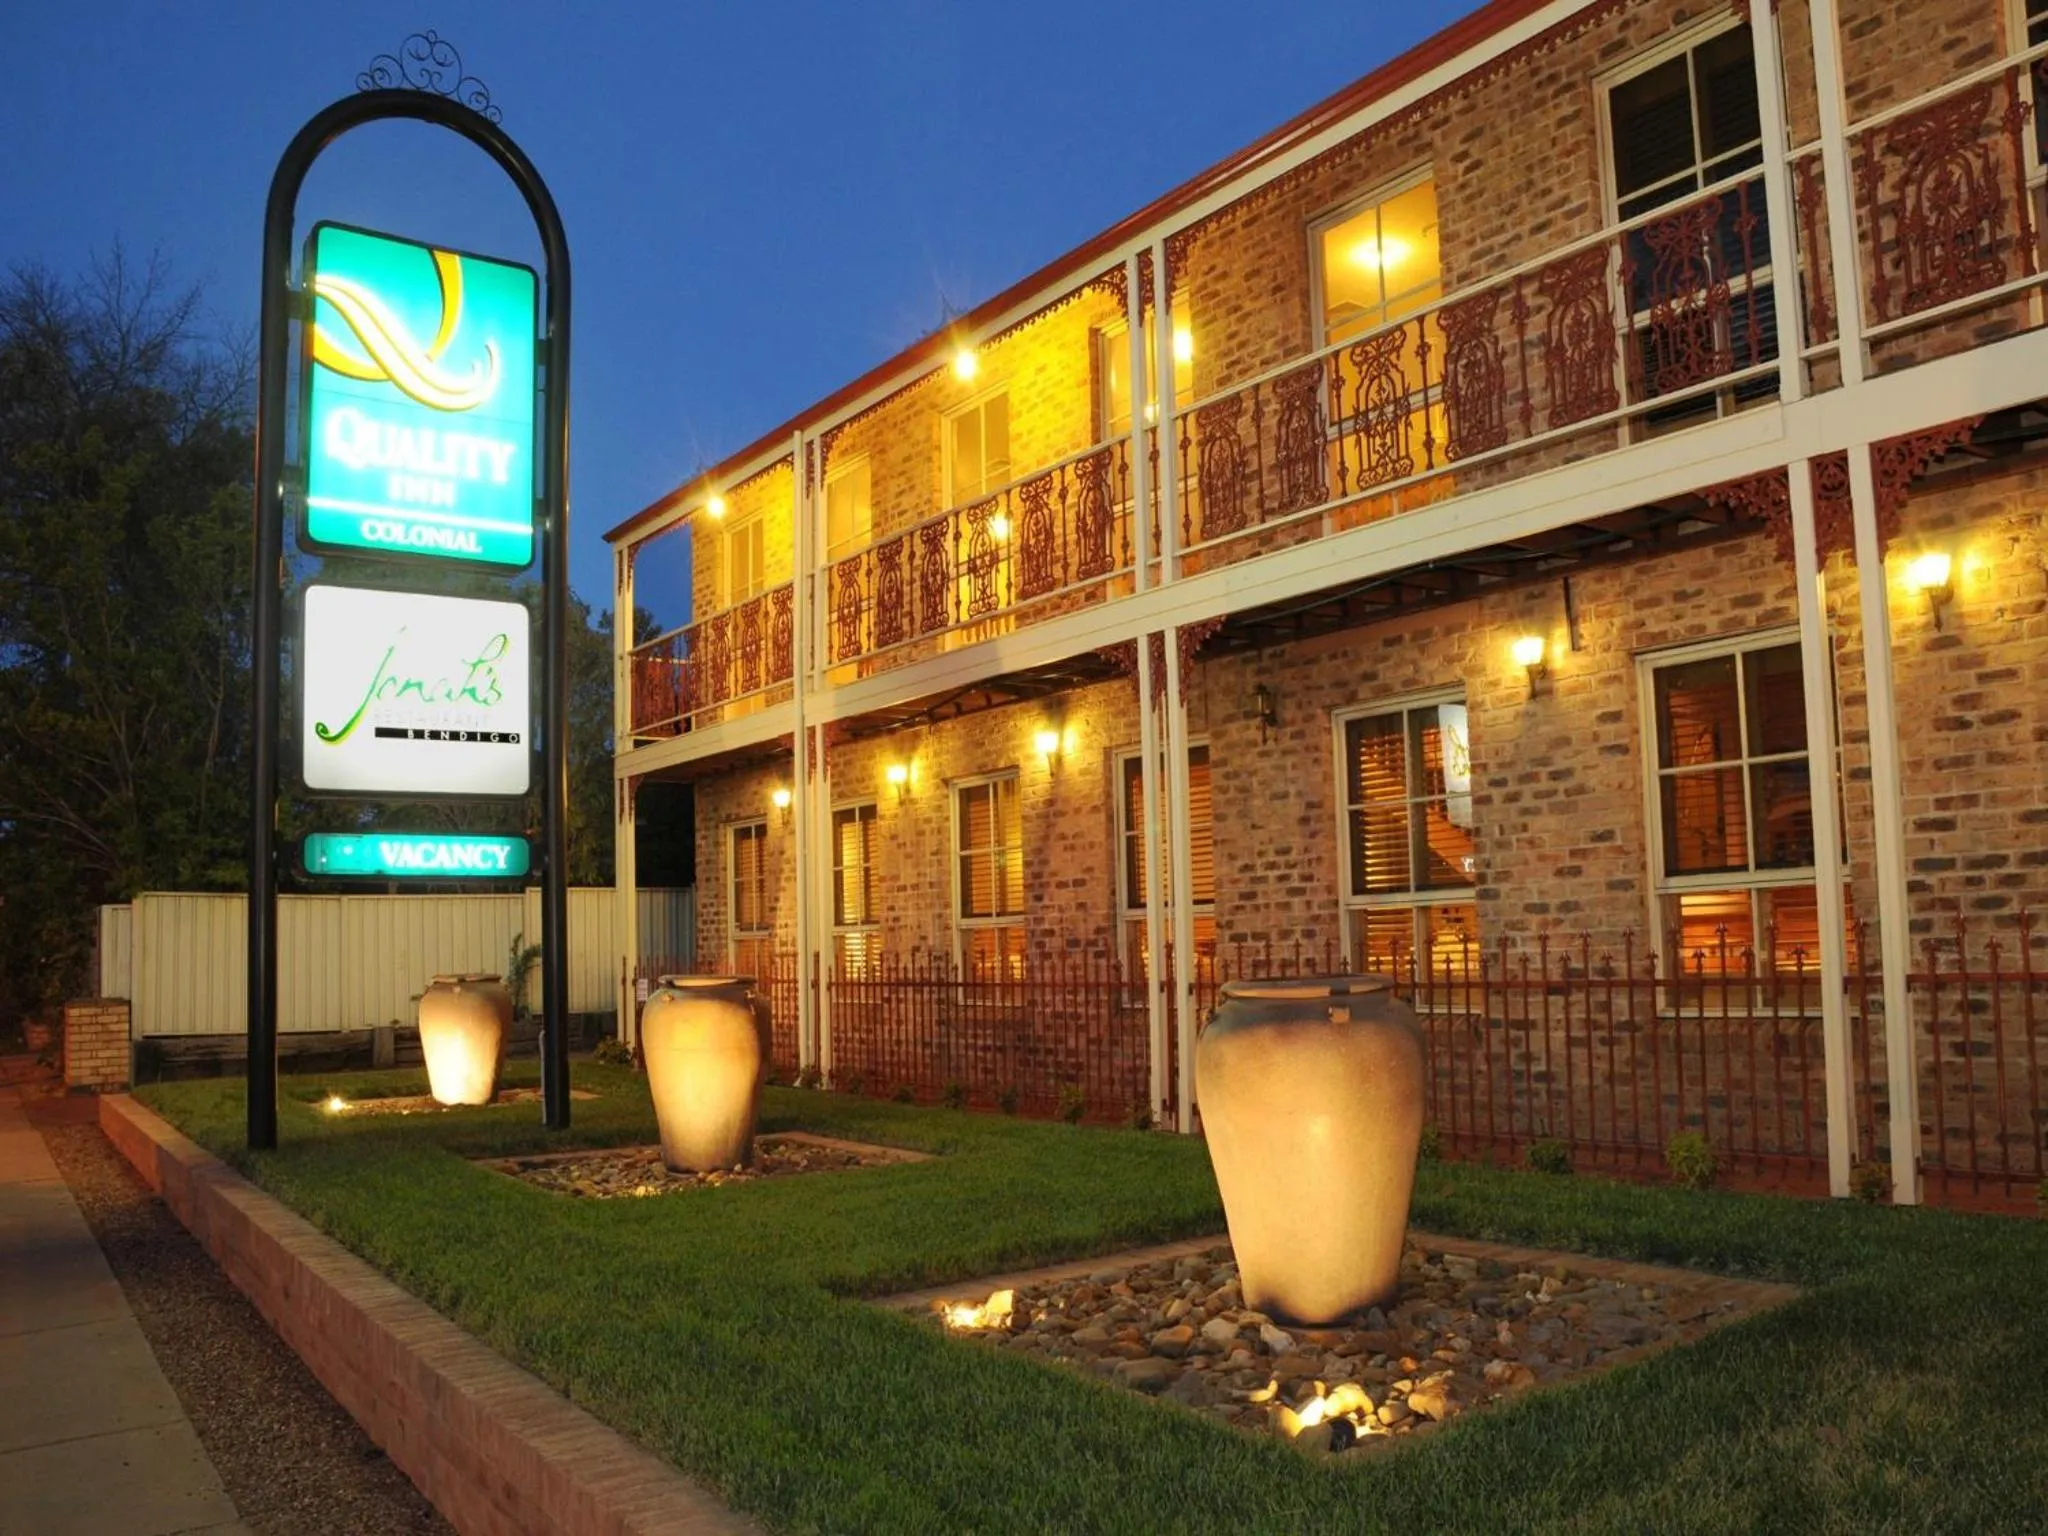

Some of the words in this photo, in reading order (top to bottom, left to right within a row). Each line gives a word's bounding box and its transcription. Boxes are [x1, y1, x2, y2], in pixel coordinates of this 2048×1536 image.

[327, 409, 515, 484] QUALITY
[390, 476, 456, 507] INN
[361, 519, 482, 553] COLONIAL
[407, 729, 519, 744] BENDIGO
[379, 841, 511, 869] VACANCY
